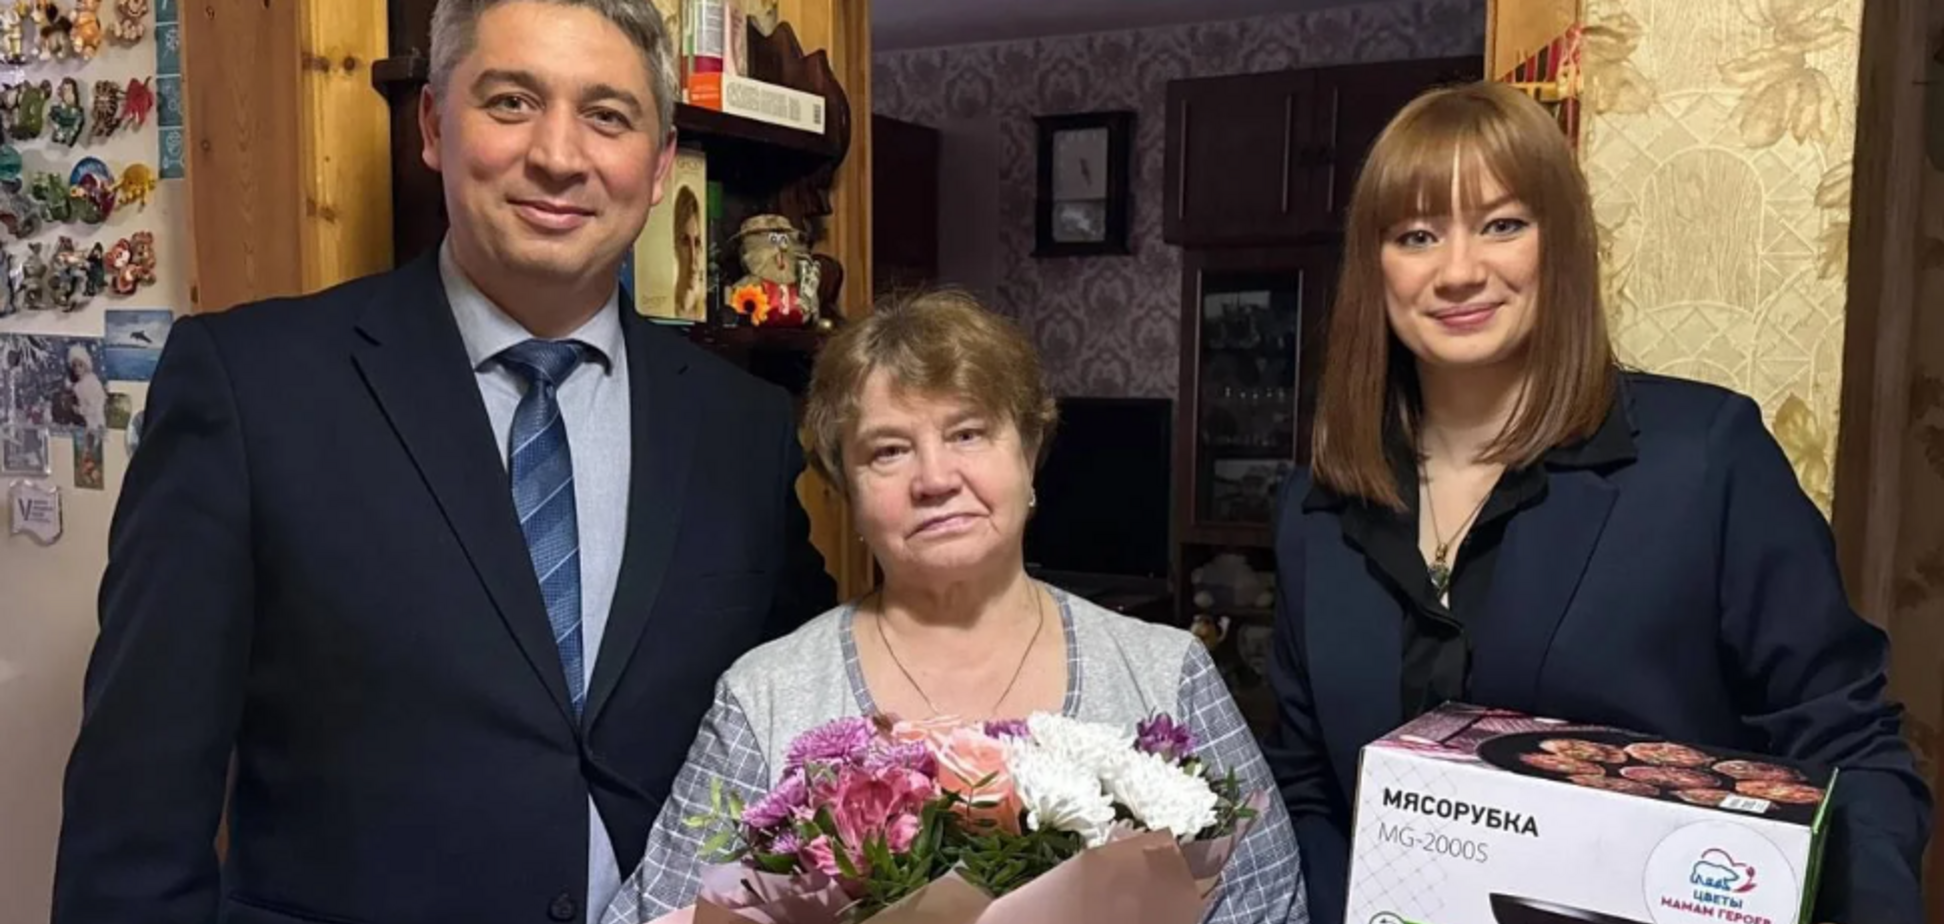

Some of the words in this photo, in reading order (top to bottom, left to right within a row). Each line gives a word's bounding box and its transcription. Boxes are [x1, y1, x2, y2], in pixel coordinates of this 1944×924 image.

[1383, 787, 1539, 837] МЯСОРУБКА
[1378, 822, 1489, 863] MG-2000S
[1661, 896, 1714, 916] МАМАМ
[1693, 889, 1743, 908] ЦВЕТЫ
